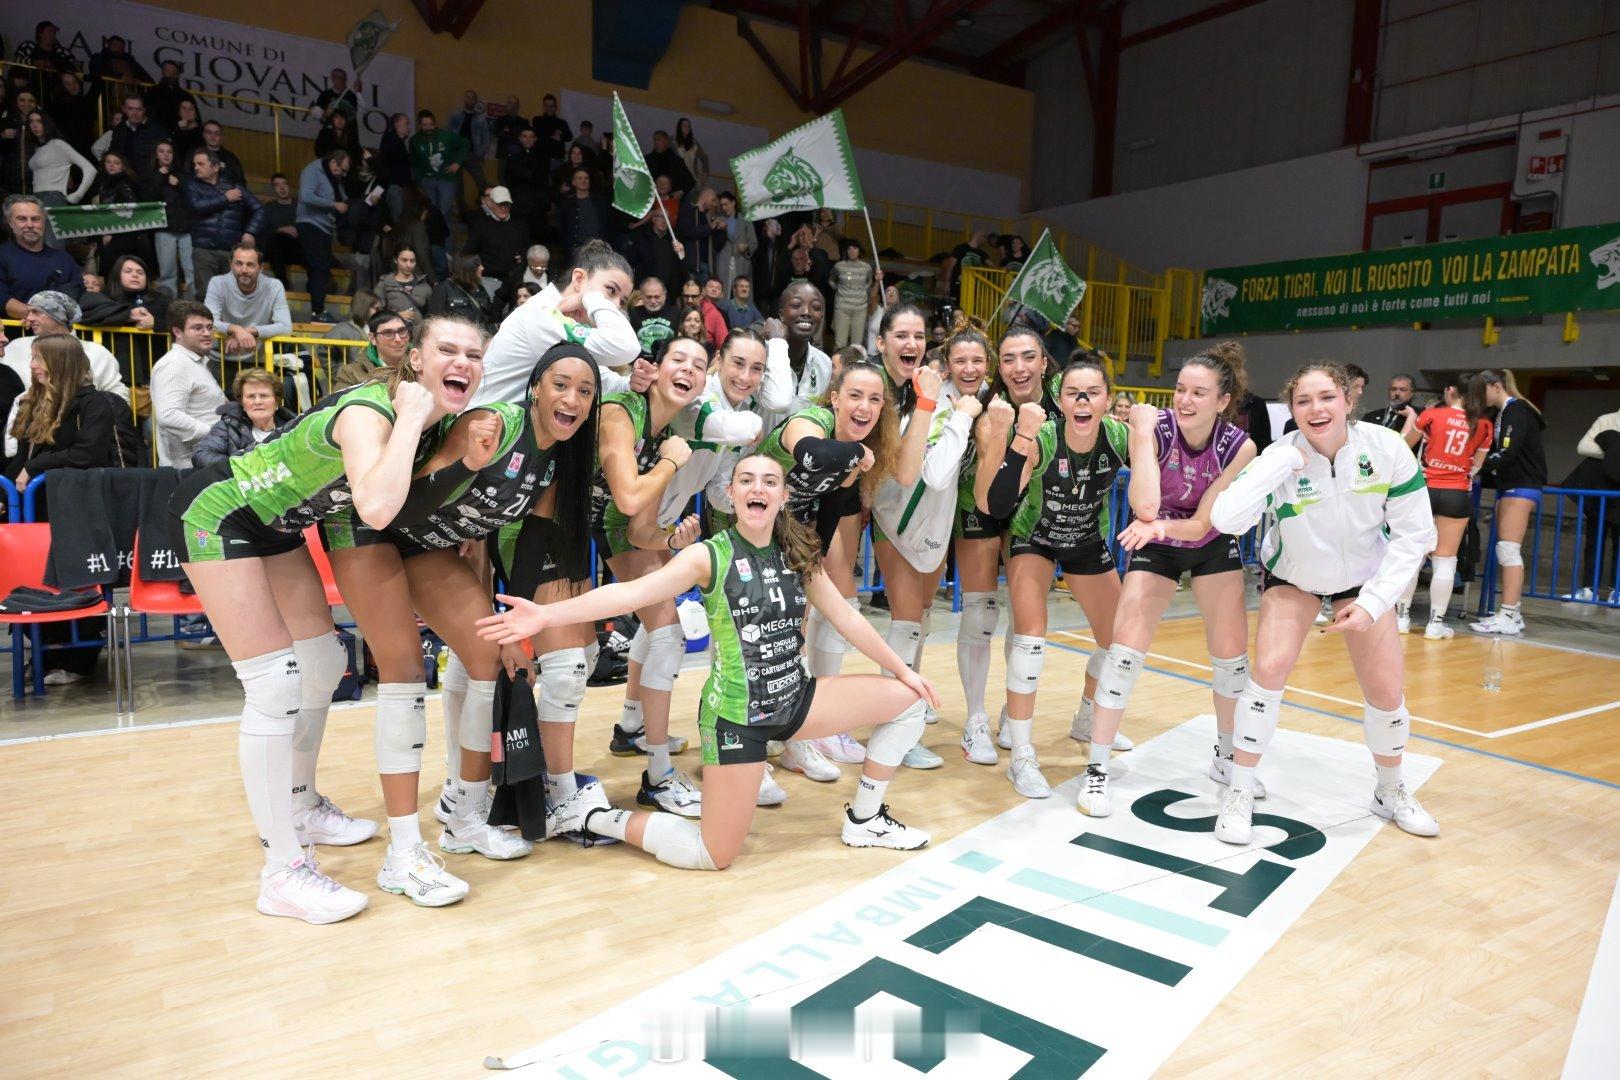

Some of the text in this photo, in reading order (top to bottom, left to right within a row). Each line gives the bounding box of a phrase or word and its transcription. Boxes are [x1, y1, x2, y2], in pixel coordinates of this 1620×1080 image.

[155, 27, 285, 62] COMUNE DI
[153, 47, 379, 108] GIOVANI
[1241, 276, 1279, 302] FORZA
[1323, 269, 1347, 295] NOI
[1351, 267, 1363, 293] IL
[1367, 259, 1432, 291] RUGGITO
[1442, 255, 1468, 285] VOI
[1472, 253, 1491, 282] LA
[1497, 243, 1580, 280] ZAMPATA
[1296, 305, 1336, 317] nessuno
[1340, 301, 1349, 314] di
[1351, 300, 1368, 313] noi
[1371, 301, 1378, 312] è
[1381, 298, 1406, 311] forte
[1410, 296, 1440, 308] come
[1444, 292, 1469, 307] tutti
[1471, 290, 1491, 304] noi
[1444, 429, 1470, 456] 13
[813, 477, 835, 492] 6
[1078, 483, 1087, 500] 1
[1178, 481, 1193, 501] 7
[502, 493, 531, 517] 21
[1062, 503, 1094, 511] MEGA
[87, 553, 111, 574] #1
[768, 586, 786, 612] 4
[732, 605, 760, 617] BHS
[760, 617, 794, 634] MEGA
